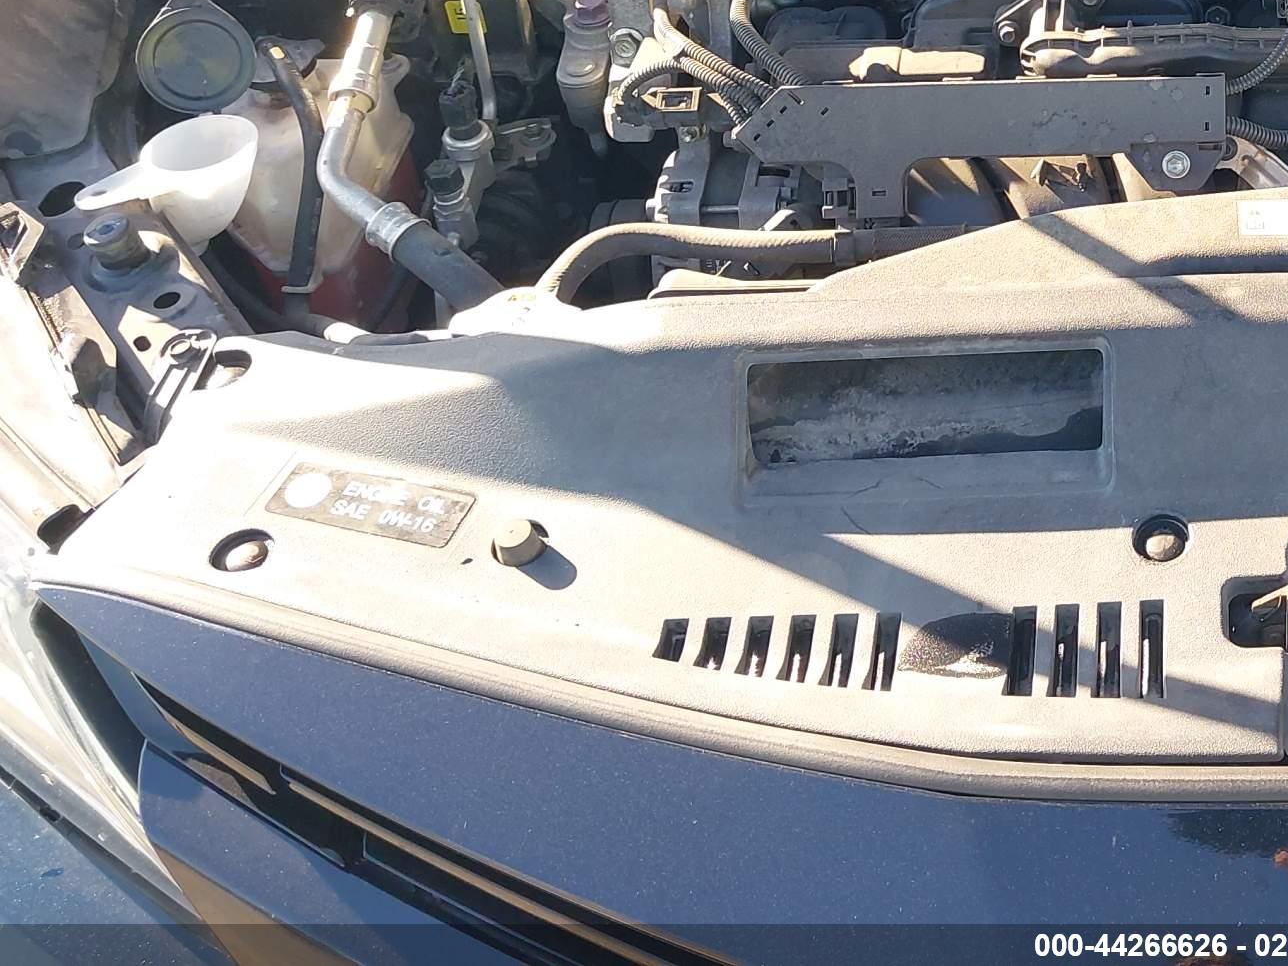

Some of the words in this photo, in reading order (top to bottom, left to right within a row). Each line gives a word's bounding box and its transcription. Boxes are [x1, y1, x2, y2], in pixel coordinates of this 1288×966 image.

[330, 499, 371, 520] SAE
[379, 510, 437, 533] 0W-16
[418, 496, 445, 514] OIL
